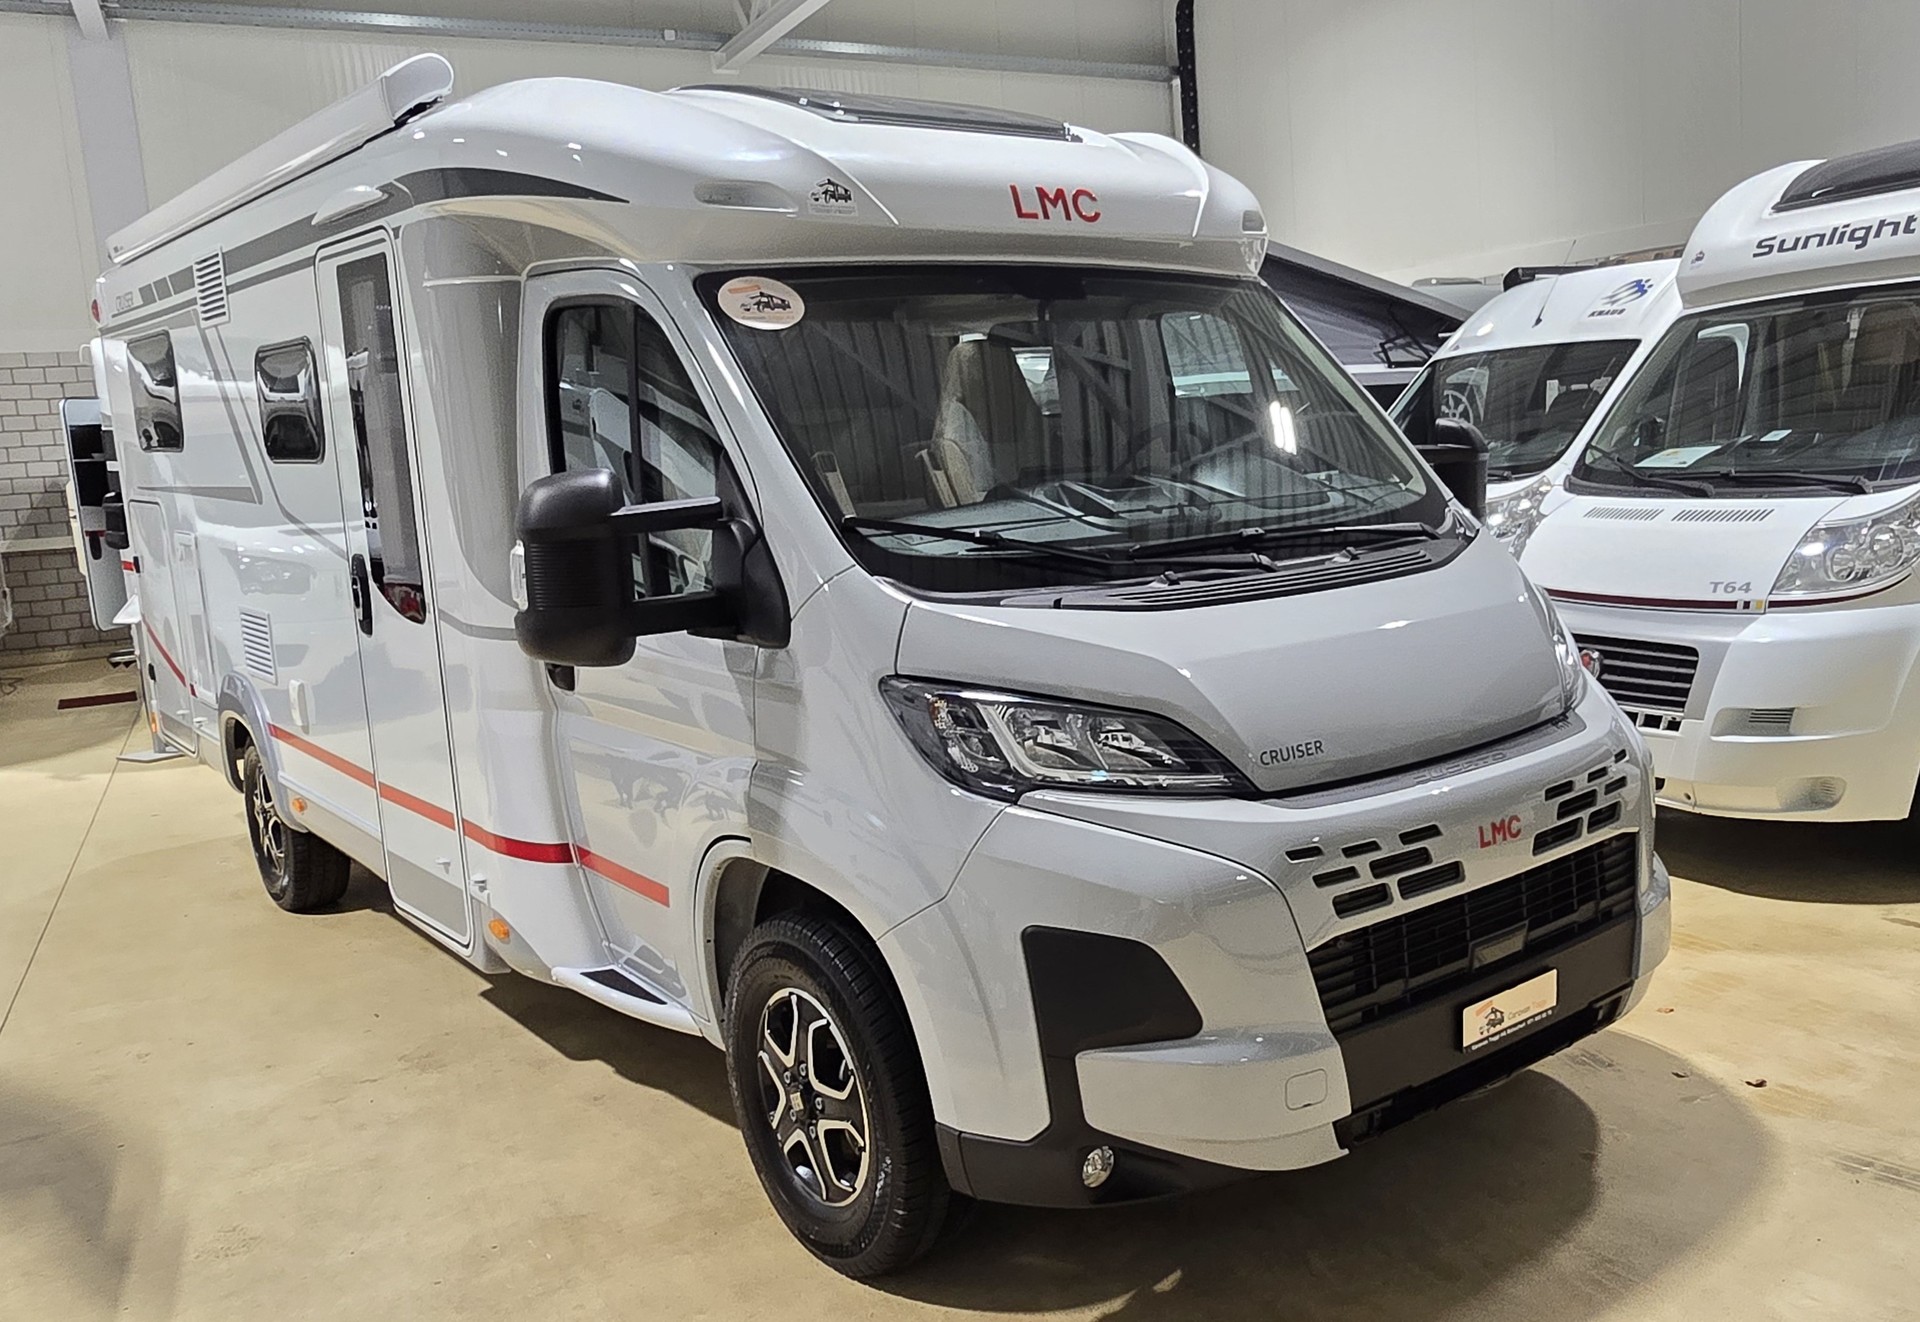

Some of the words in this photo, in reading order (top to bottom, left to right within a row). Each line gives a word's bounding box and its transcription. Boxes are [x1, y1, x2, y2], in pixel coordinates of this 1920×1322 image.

[1009, 184, 1101, 223] LMC
[1752, 214, 1918, 258] Sunlight
[1709, 581, 1752, 594] T64
[1260, 740, 1325, 766] CRUISER
[1478, 814, 1522, 849] LMC
